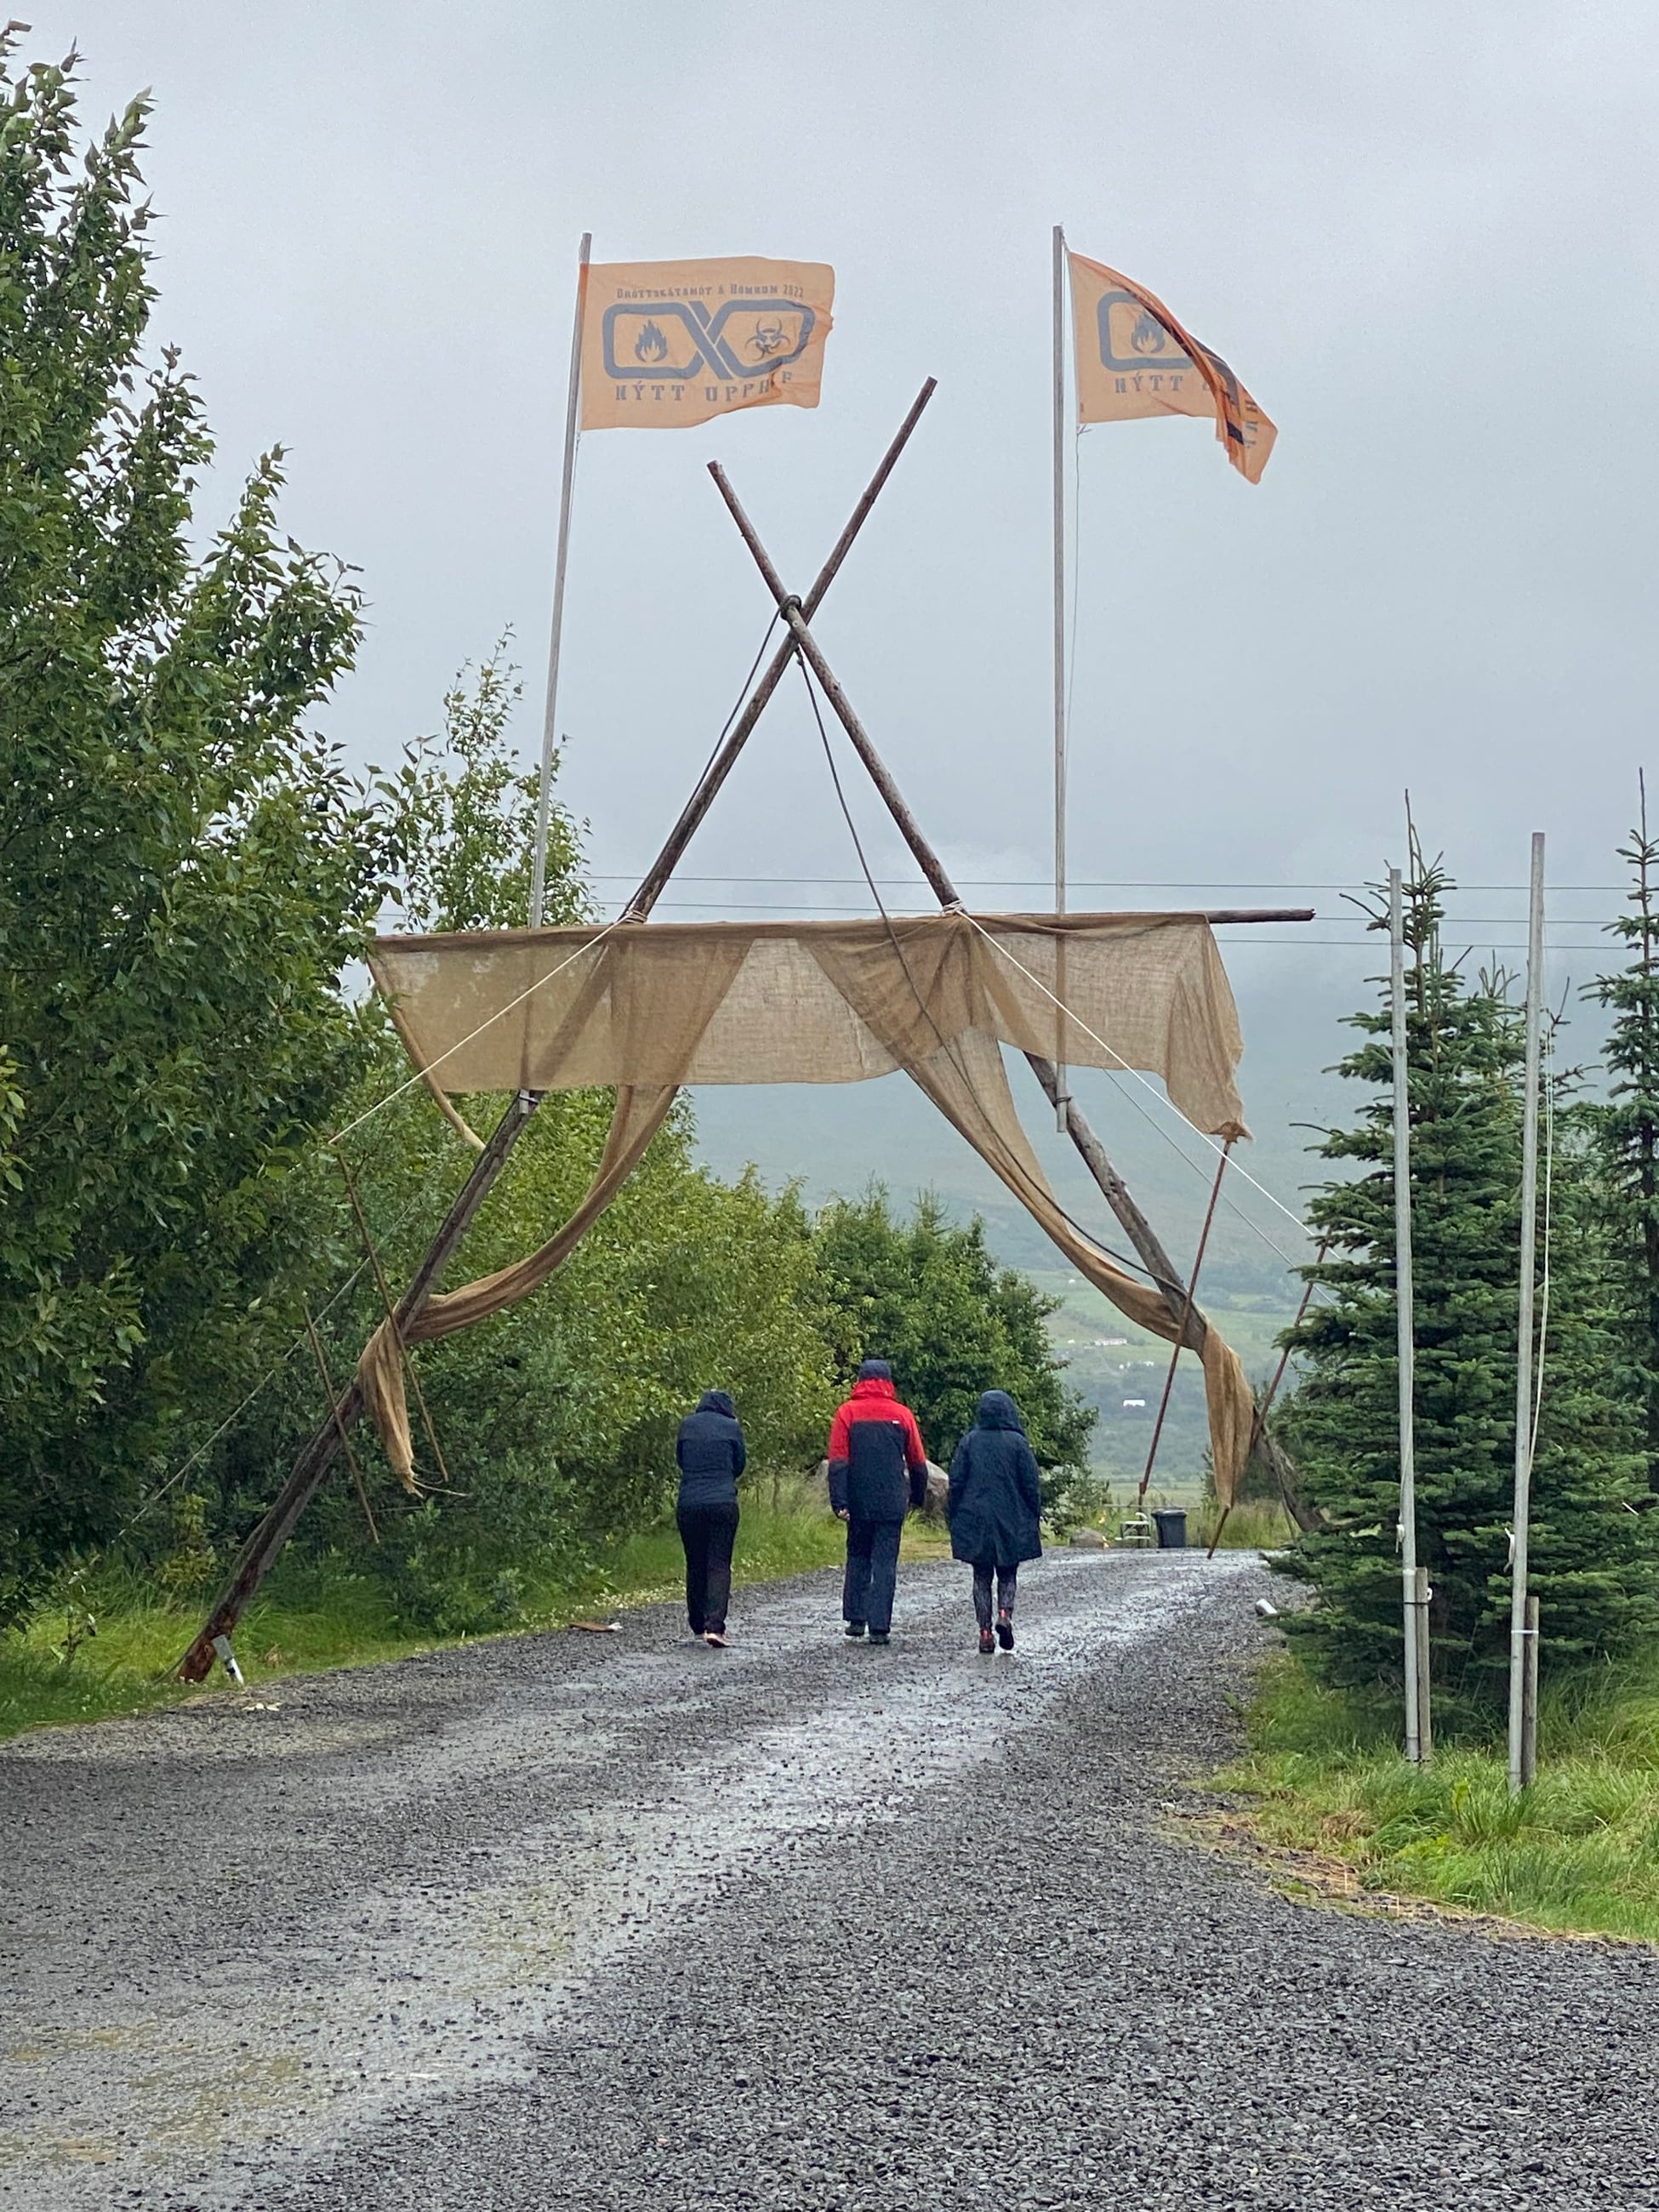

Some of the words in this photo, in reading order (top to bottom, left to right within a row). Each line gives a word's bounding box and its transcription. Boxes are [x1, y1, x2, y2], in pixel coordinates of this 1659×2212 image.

[783, 283, 804, 298] 2022
[615, 380, 685, 401] NÝTT
[705, 370, 793, 402] UPPHF
[1115, 371, 1183, 393] NÝTT
